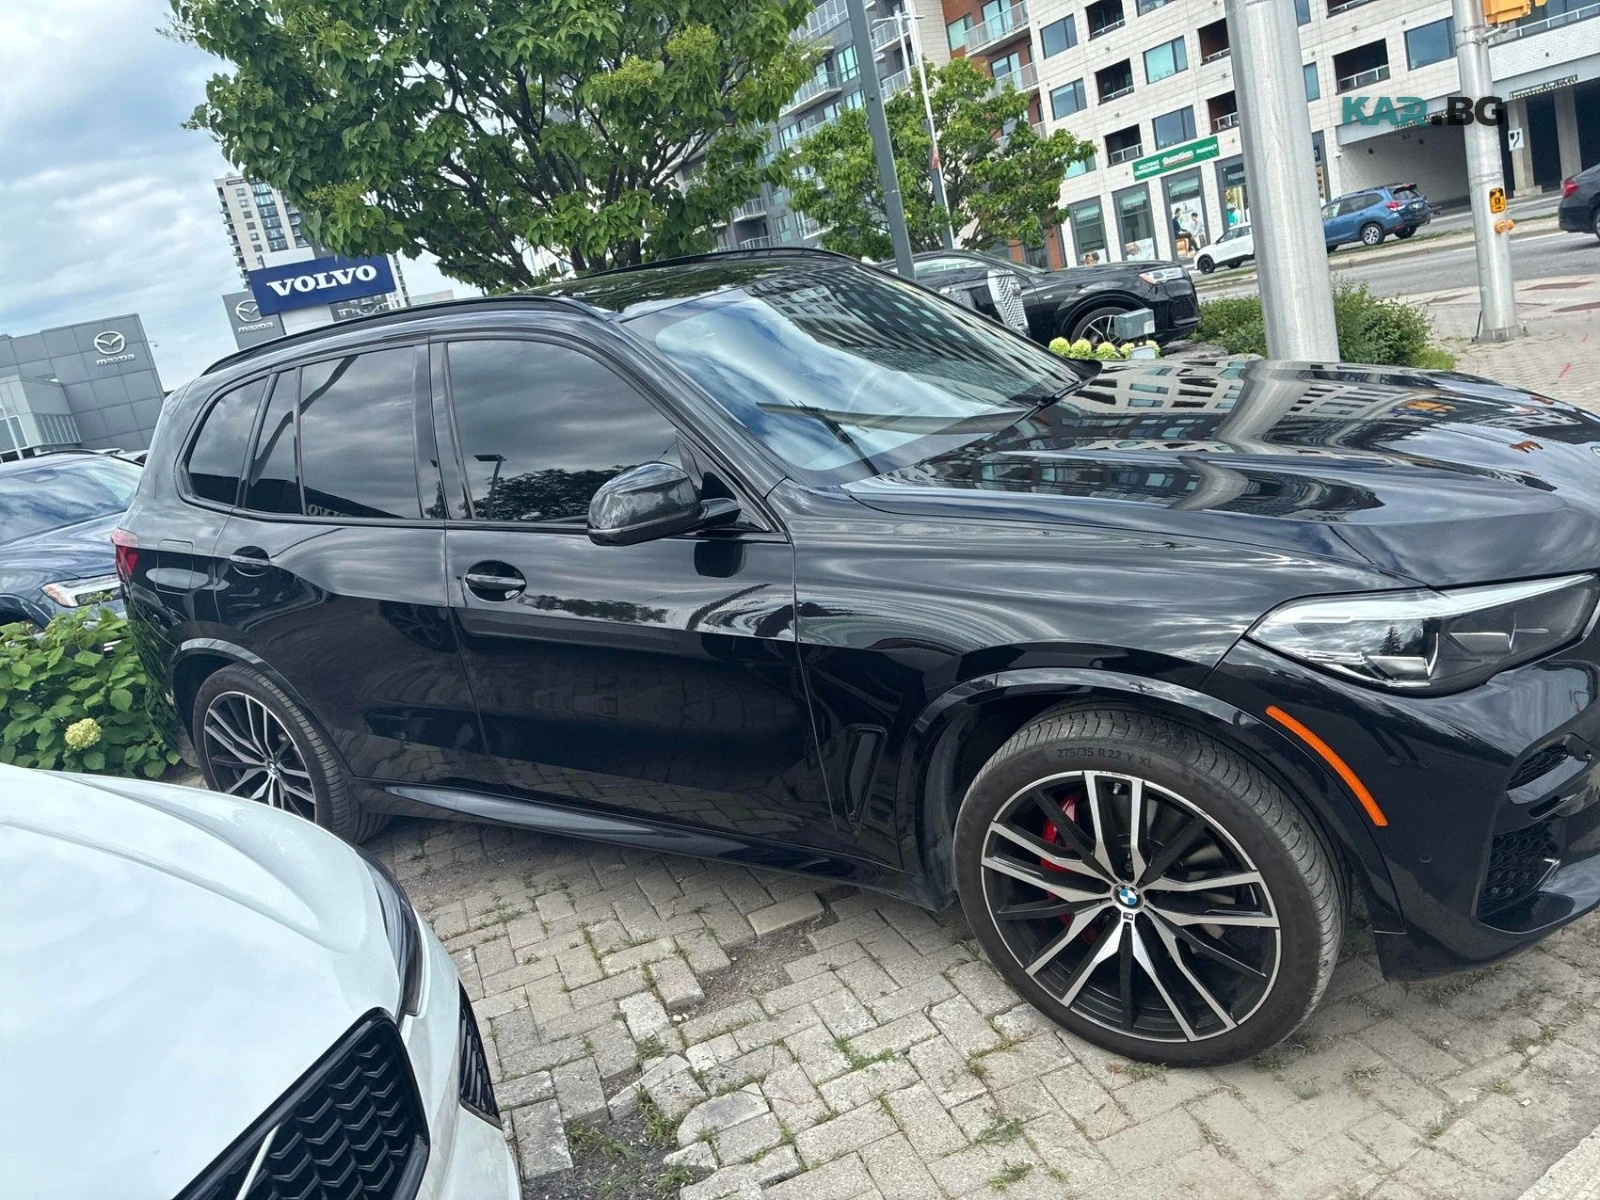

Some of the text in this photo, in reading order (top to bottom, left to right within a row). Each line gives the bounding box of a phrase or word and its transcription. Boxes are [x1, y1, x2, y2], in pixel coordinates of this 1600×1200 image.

[267, 265, 377, 296] VOLVO
[1057, 747, 1094, 758] 275/35
[1138, 756, 1153, 768] XL
